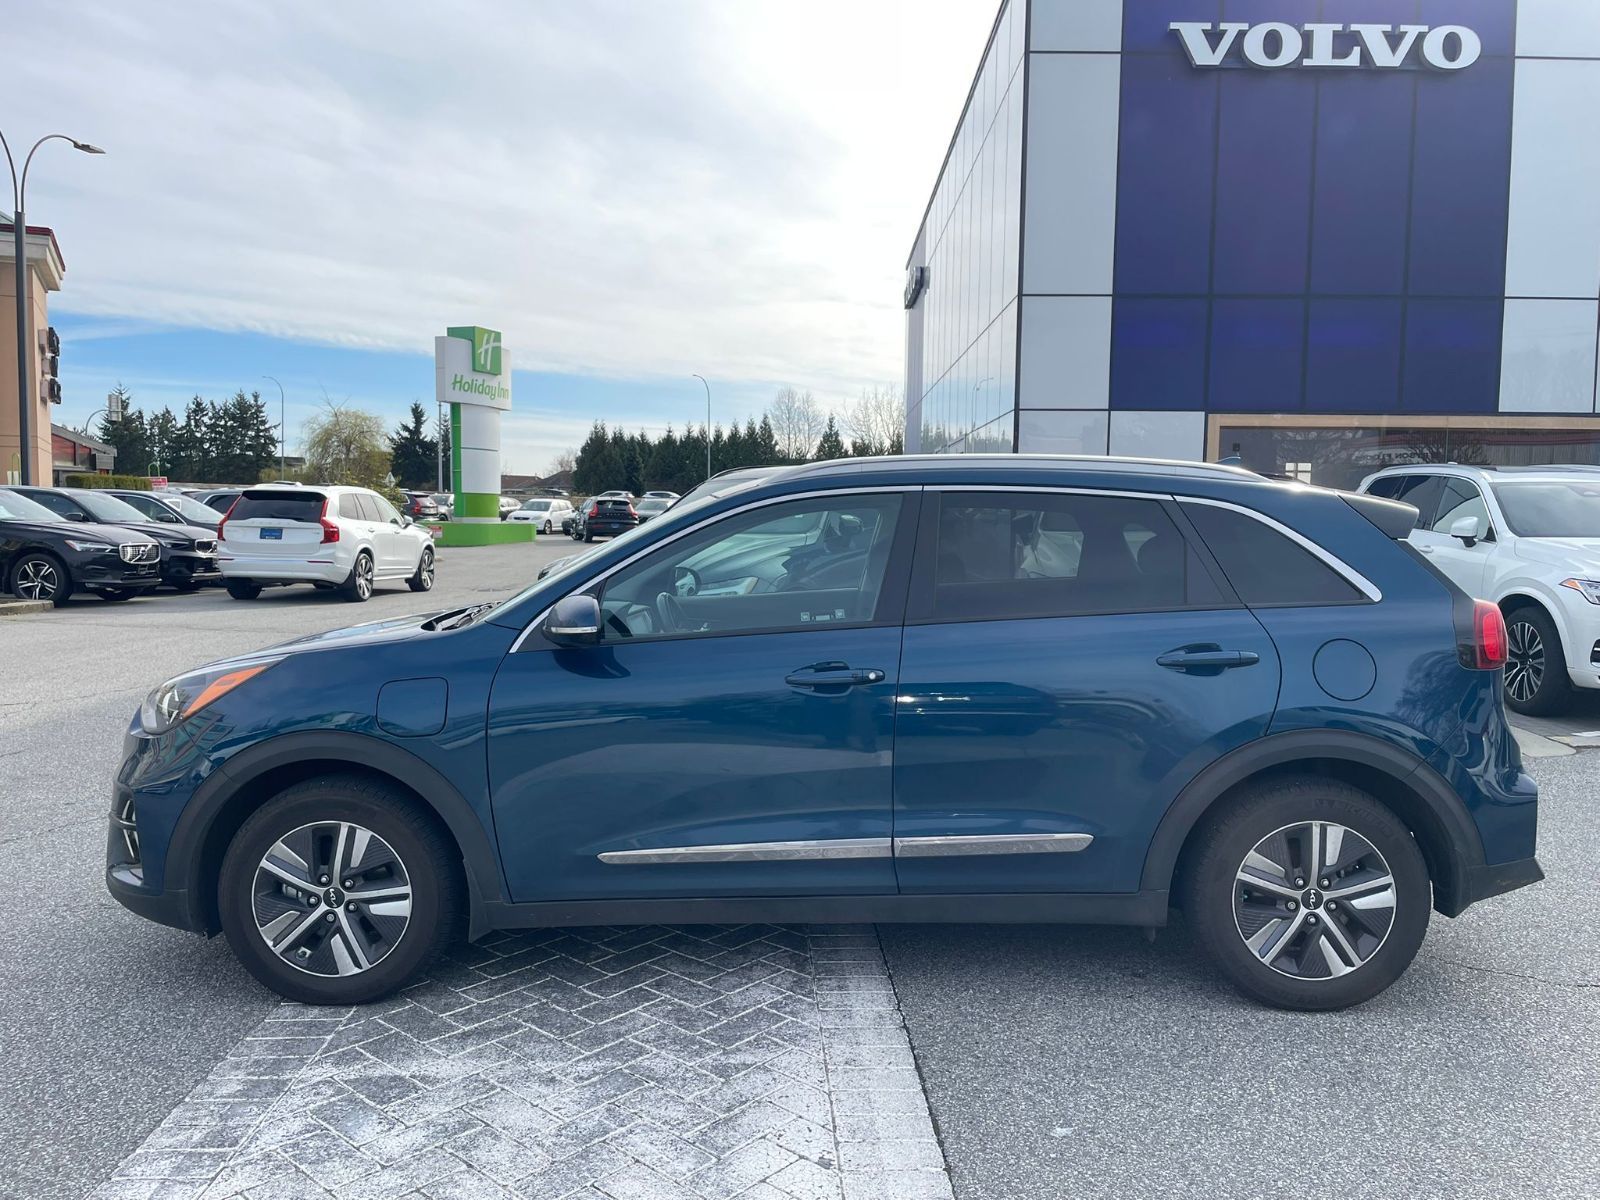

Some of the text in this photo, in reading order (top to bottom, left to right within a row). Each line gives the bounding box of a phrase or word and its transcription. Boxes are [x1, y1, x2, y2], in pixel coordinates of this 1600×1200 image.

[1169, 21, 1482, 70] VOLVO
[451, 373, 509, 401] Holiday Inn
